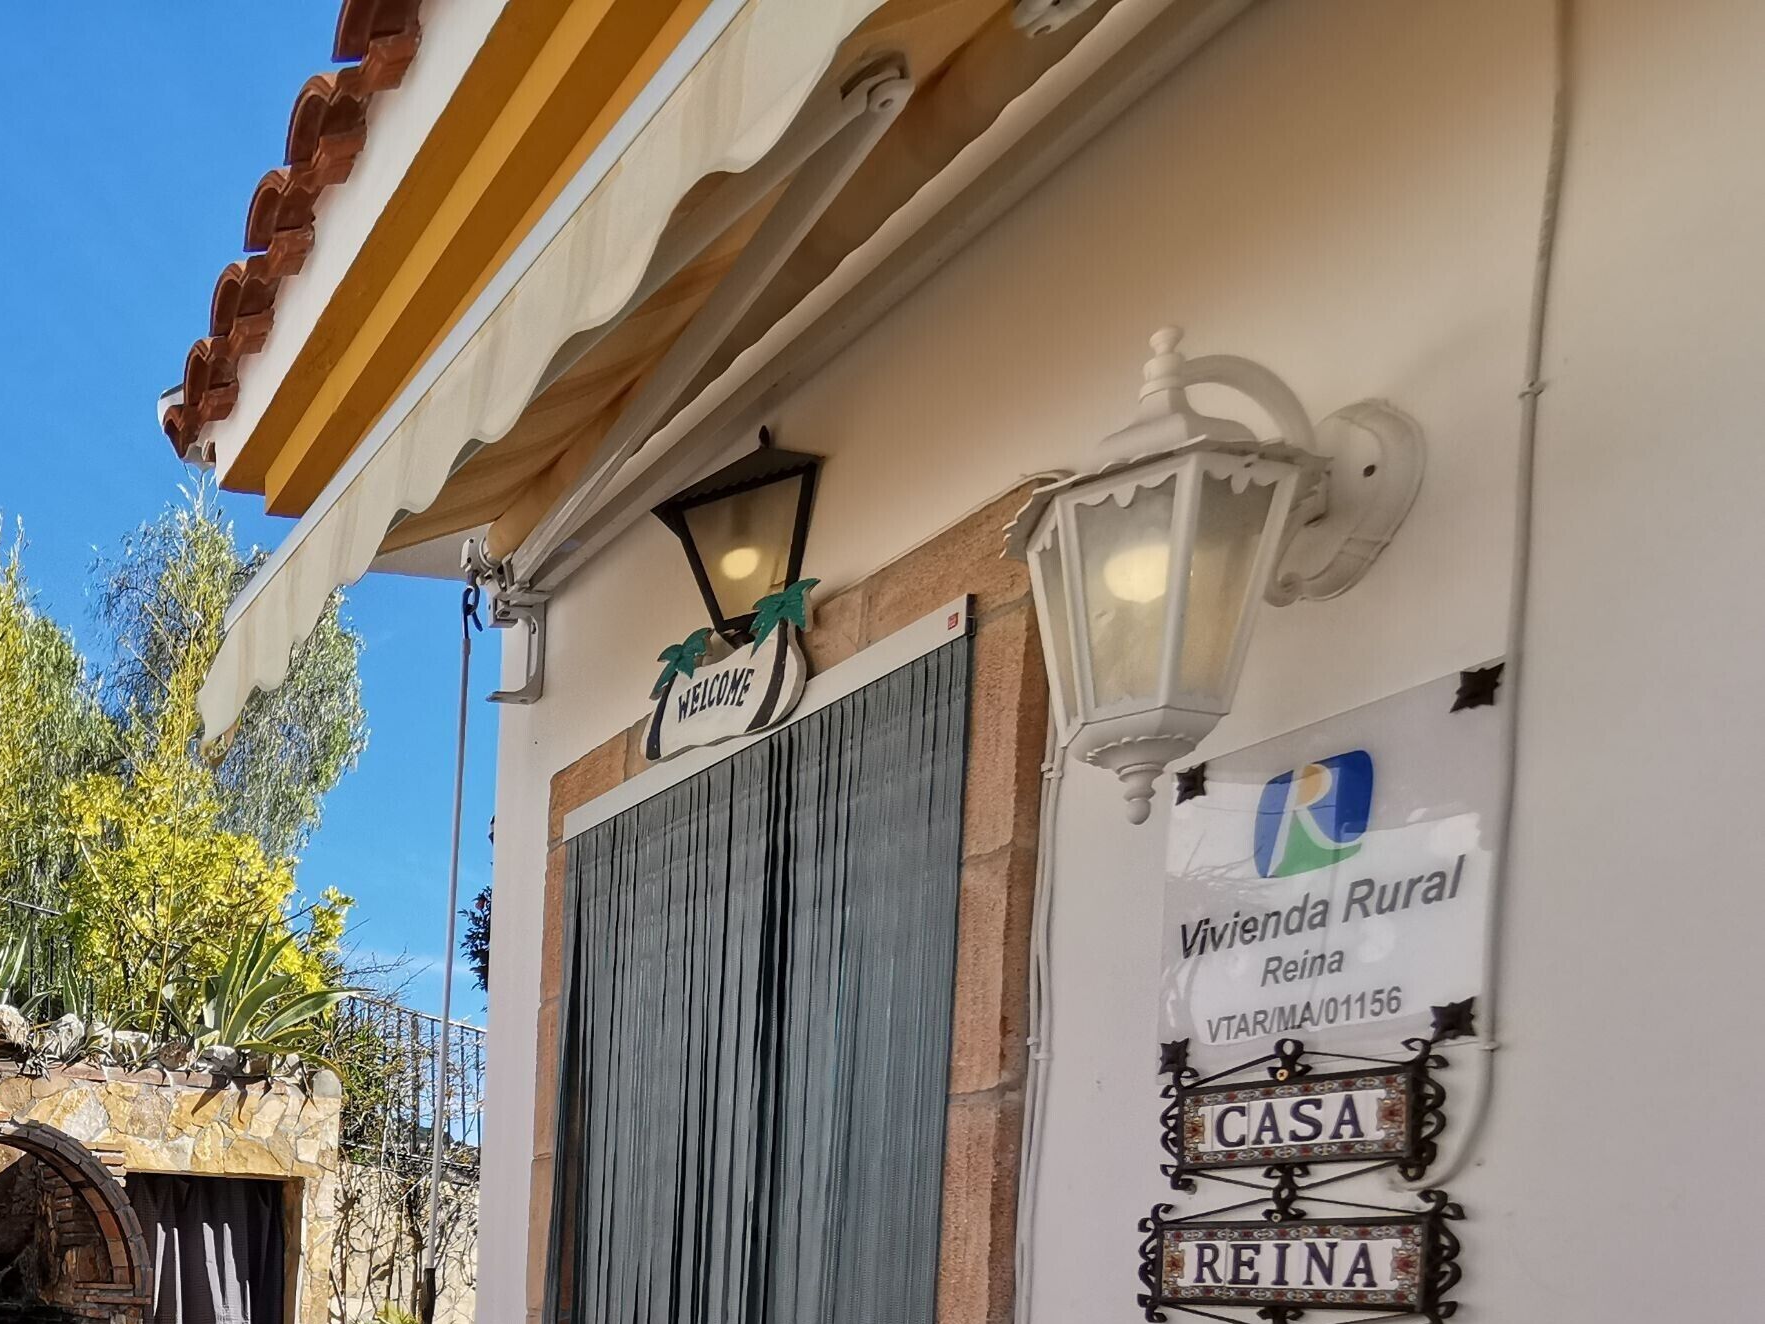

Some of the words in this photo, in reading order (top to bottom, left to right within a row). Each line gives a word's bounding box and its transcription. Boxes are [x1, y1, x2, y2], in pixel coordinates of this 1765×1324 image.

[678, 667, 755, 723] WELCOME
[1180, 892, 1330, 959] Vivienda
[1341, 854, 1467, 923] Rural
[1260, 949, 1345, 987] Reina
[1206, 986, 1402, 1043] VTAR/MA/01156
[1215, 1094, 1365, 1148] CASA
[1192, 1242, 1378, 1288] REINA
